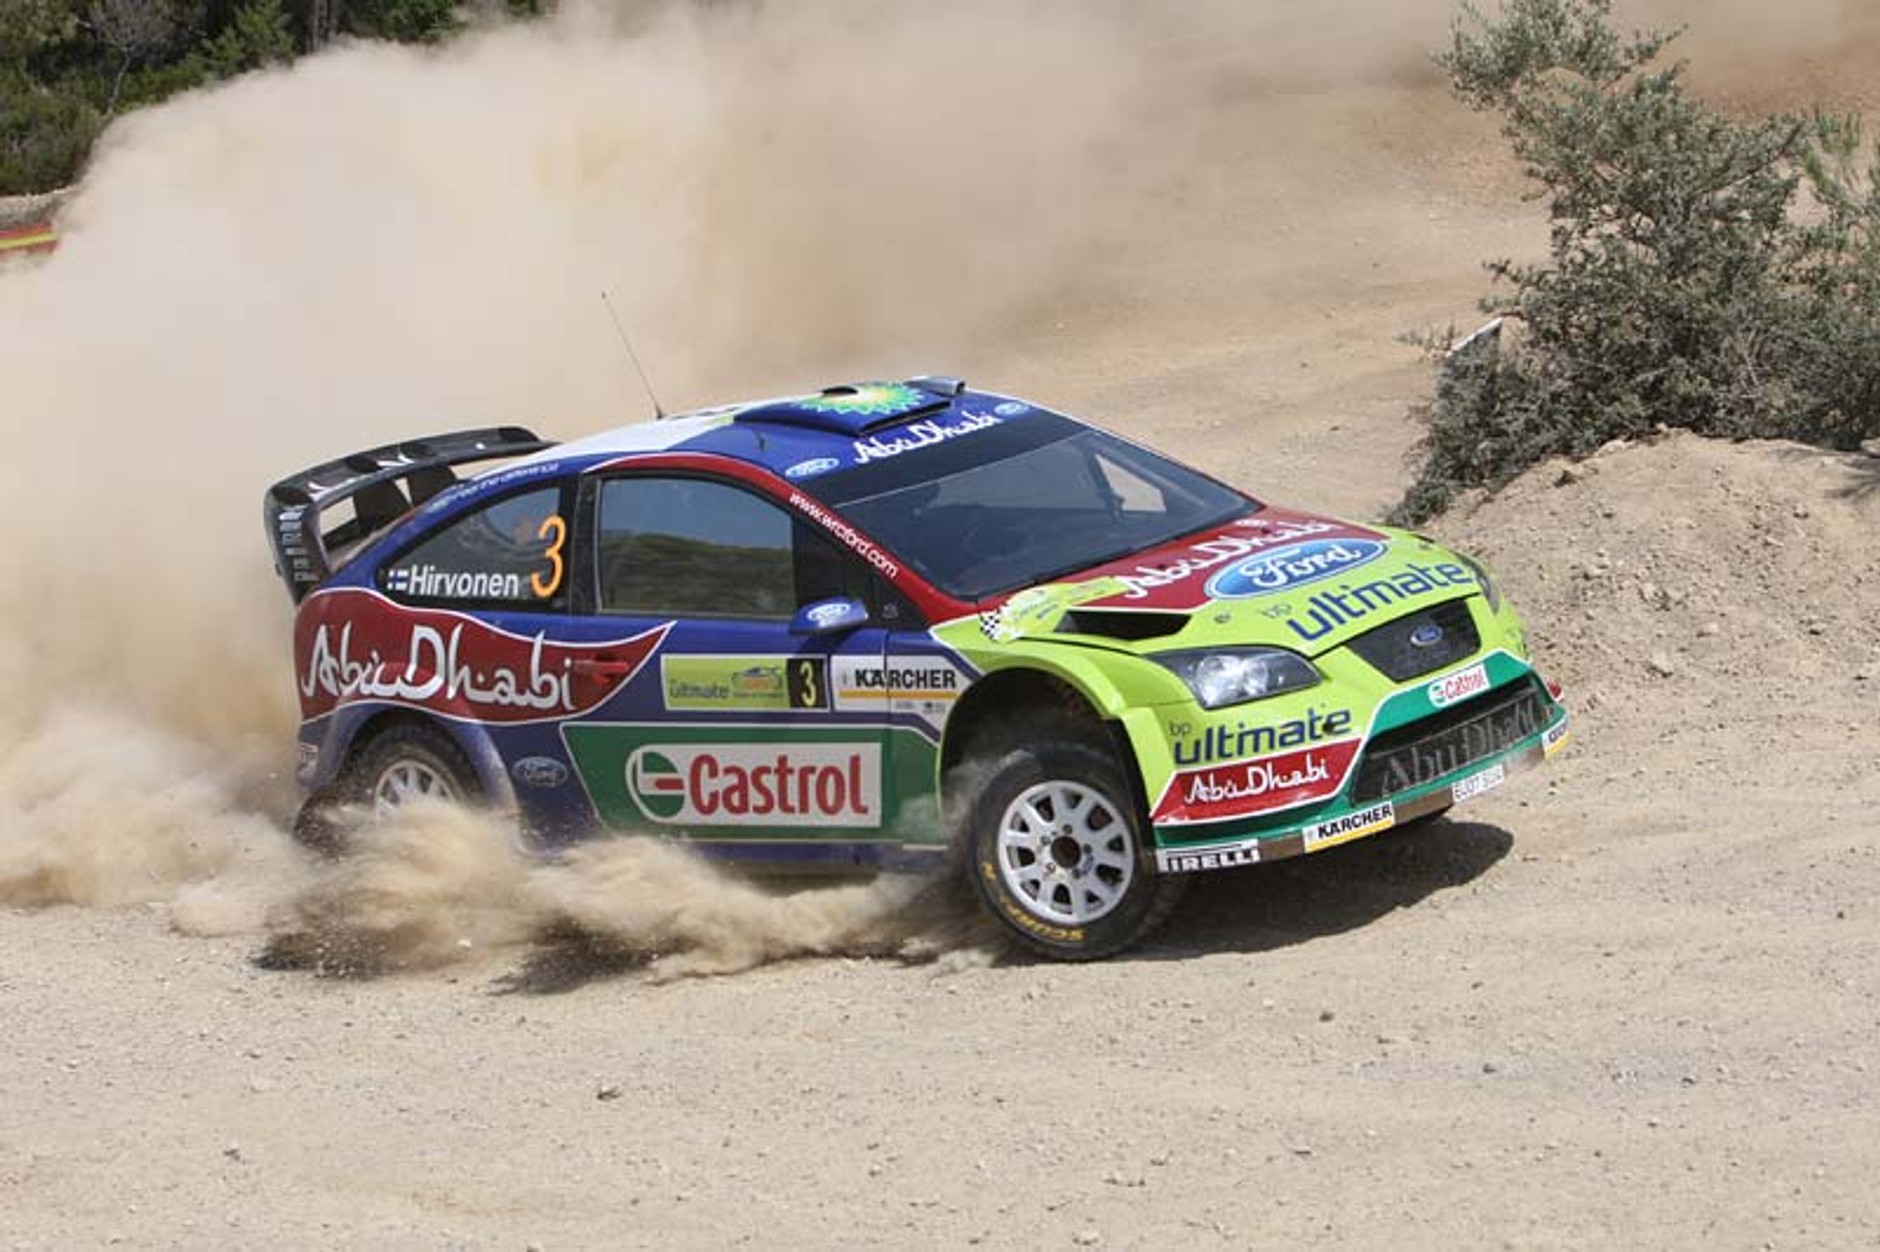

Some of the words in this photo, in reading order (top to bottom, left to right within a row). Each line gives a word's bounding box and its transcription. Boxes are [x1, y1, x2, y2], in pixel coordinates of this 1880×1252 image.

[408, 565, 520, 598] Hirvonen
[530, 515, 567, 598] 3
[1240, 543, 1362, 588] Ford
[1286, 563, 1473, 641] ultimate
[800, 661, 817, 706] 3
[1174, 707, 1352, 764] ultimate
[688, 754, 869, 816] Castrol
